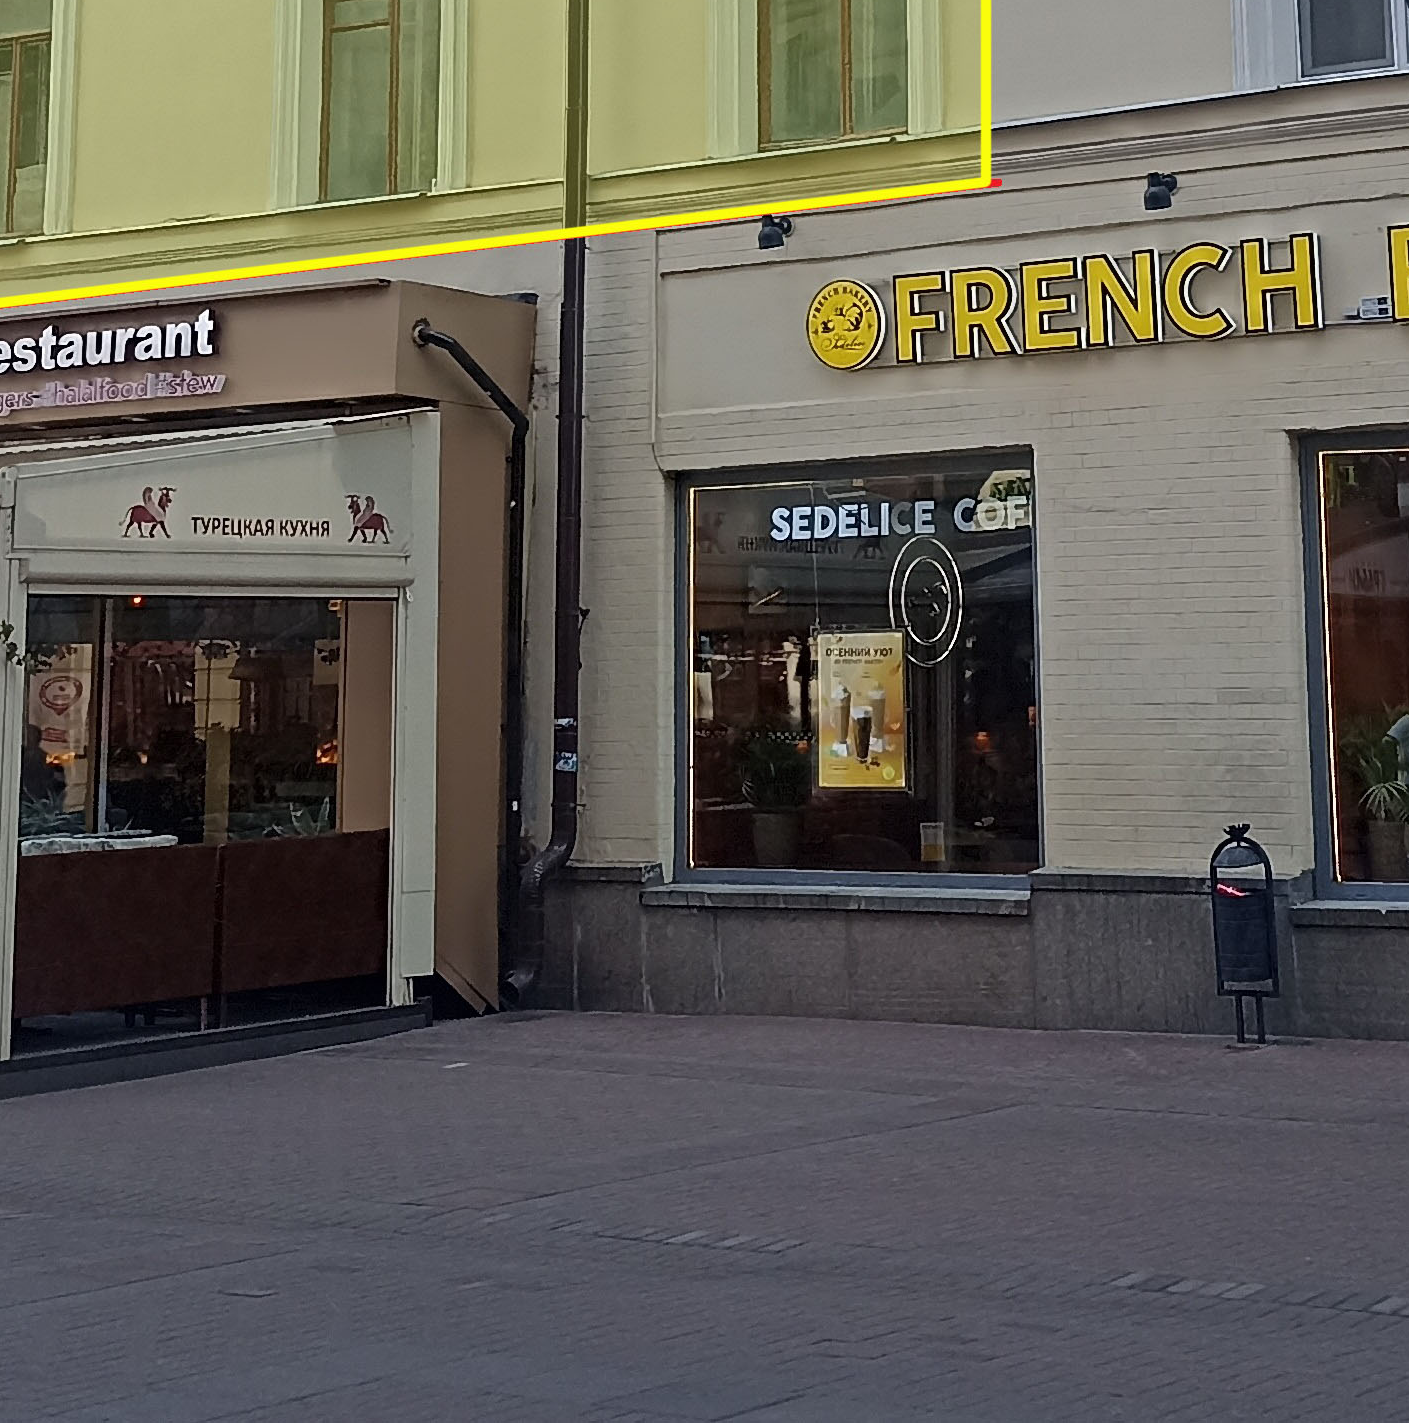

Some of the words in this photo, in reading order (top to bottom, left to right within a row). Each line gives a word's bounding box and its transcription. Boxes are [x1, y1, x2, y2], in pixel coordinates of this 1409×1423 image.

[893, 232, 1325, 363] FRENCH
[155, 370, 226, 395] #stew
[191, 516, 275, 539] ТУРЕЦКАЯ
[279, 518, 330, 538] КУХНЯ
[770, 500, 936, 541] SEDELICE
[954, 495, 1028, 532] COF
[826, 646, 871, 658] ОСЕННИЙ
[873, 647, 893, 658] УЮТ
